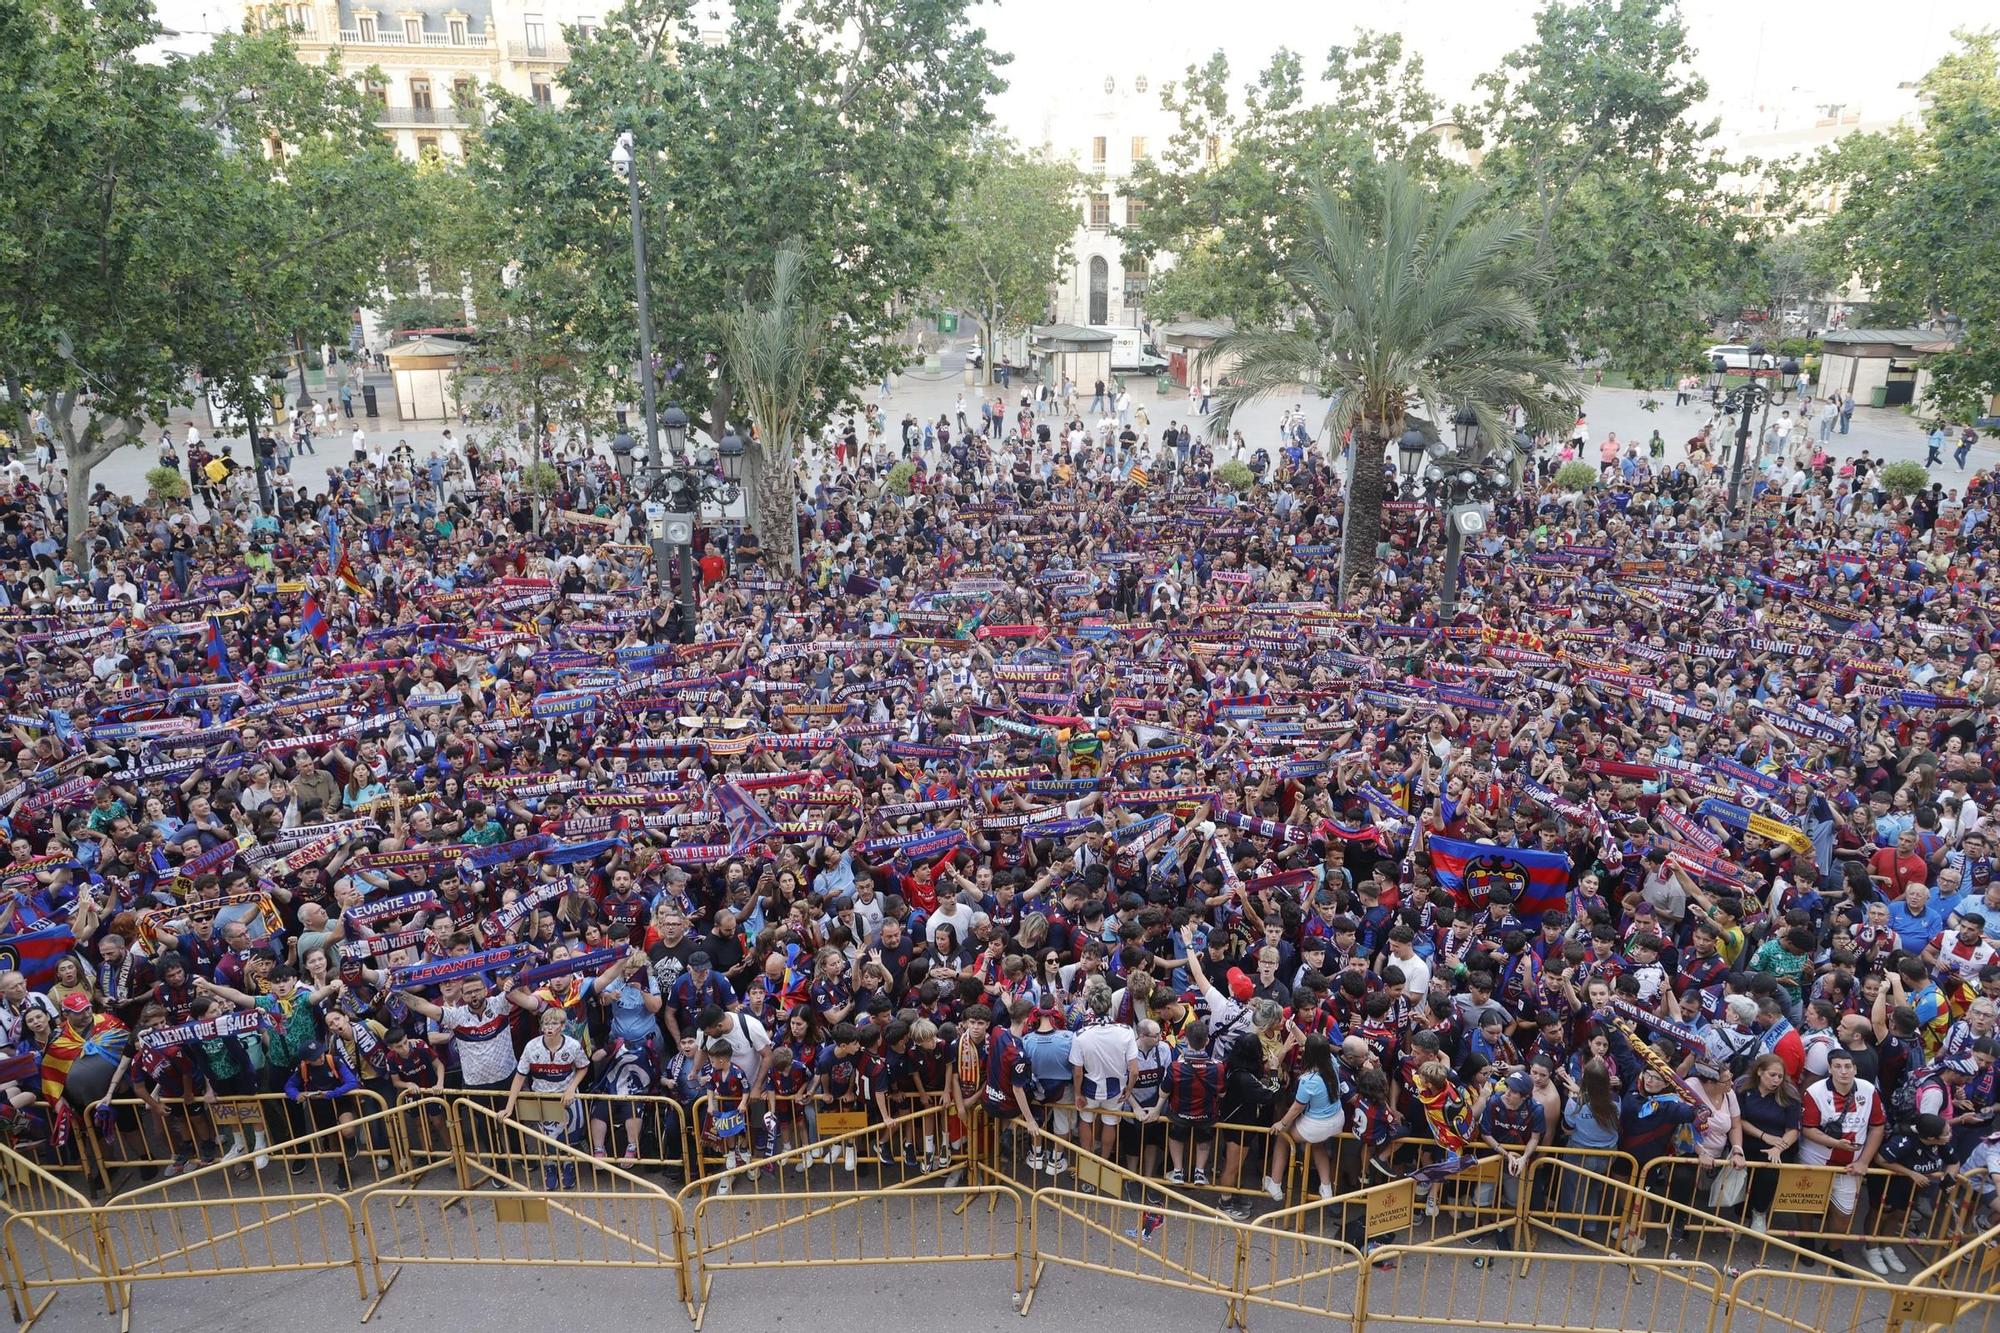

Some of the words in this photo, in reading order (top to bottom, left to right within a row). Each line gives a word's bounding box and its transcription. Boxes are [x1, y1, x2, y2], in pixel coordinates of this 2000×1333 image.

[1032, 575, 1066, 585] LEVANTE
[432, 594, 465, 602] LEVANTE
[70, 601, 107, 612] LEVANTE
[111, 601, 123, 610] UD
[1311, 626, 1339, 636] LEVANTE
[1175, 634, 1218, 642] LEVANTE
[1553, 633, 1596, 642] LEVANTE
[619, 650, 651, 658] LEVANTE
[654, 647, 665, 655] UD
[781, 642, 811, 652] LEVANTE
[1678, 642, 1694, 653] UD
[1695, 644, 1737, 660] LEVANTE
[1751, 638, 1795, 653] LEVANTE
[1798, 644, 1813, 656] UD
[1508, 651, 1518, 659] DE
[1431, 662, 1475, 673] LEVANTE
[262, 675, 297, 686] LEVANTE
[299, 672, 315, 680] U.D.
[994, 671, 1036, 680] LEVANTE
[1044, 672, 1061, 680] U.D.
[1589, 670, 1637, 685] LEVANTE
[1640, 679, 1654, 687] UD
[579, 678, 614, 686] LEVANTE
[322, 689, 334, 697] UD
[678, 689, 708, 701] LEVANTE
[709, 691, 719, 701] UD
[352, 704, 367, 713] UD
[536, 702, 576, 714] LEVANTE
[580, 699, 593, 708] UD
[9, 715, 34, 724] LEVANTE
[95, 728, 120, 736] LEVANTE
[140, 722, 172, 732] OLYMPIACOS
[885, 722, 898, 730] UD
[1763, 711, 1814, 736] LEVANTE
[1817, 730, 1835, 742] UD
[268, 735, 323, 749] LEVANTE
[765, 739, 815, 747] LEVANTE
[817, 740, 833, 748] UD
[1146, 746, 1187, 758] LEVANTE
[623, 770, 678, 785] LEVANTE
[973, 767, 1030, 780] LEVANTE
[1031, 780, 1075, 790] LEVANTE
[1078, 780, 1094, 789] UD
[1761, 779, 1774, 790] UD
[513, 785, 546, 797] CALIENTA
[1121, 789, 1187, 801] LEVANTE
[583, 794, 645, 805] LEVANTE
[655, 792, 680, 802] U.D.
[644, 814, 676, 826] CALIENTA
[676, 813, 692, 825] QUE
[700, 811, 721, 824] SALES
[982, 817, 1019, 828] GRANOTES
[1020, 815, 1030, 825] DE
[1030, 806, 1062, 824] PRIMERA
[1711, 805, 1735, 819] LEVANTE
[1737, 814, 1747, 822] UD
[565, 815, 611, 831] LEVANTE
[1662, 806, 1676, 821] SOM
[1677, 816, 1686, 827] DE
[1687, 823, 1718, 850] PRIMERA
[1750, 818, 1788, 837] MOTHERWELL
[870, 835, 919, 847] LEVANTE
[921, 831, 937, 839] UD
[370, 853, 430, 866] LEVANTE
[443, 849, 462, 858] UD
[667, 848, 689, 859] SOM
[692, 847, 706, 858] DE
[547, 878, 568, 899] SALES
[1472, 885, 1489, 895] LEVA
[347, 899, 404, 919] LEVANTE
[410, 892, 427, 904] UD
[370, 936, 388, 953] QUE
[412, 958, 485, 980] LEVANTE
[488, 951, 510, 965] UD
[1615, 1001, 1638, 1016] PENYA
[1640, 1010, 1659, 1025] VENT
[1660, 1019, 1671, 1030] DE
[194, 1023, 215, 1038] QUE
[227, 1012, 258, 1031] SALES
[765, 1127, 775, 1157] LEVA
[1370, 1207, 1408, 1219] AJUNTAMENT
